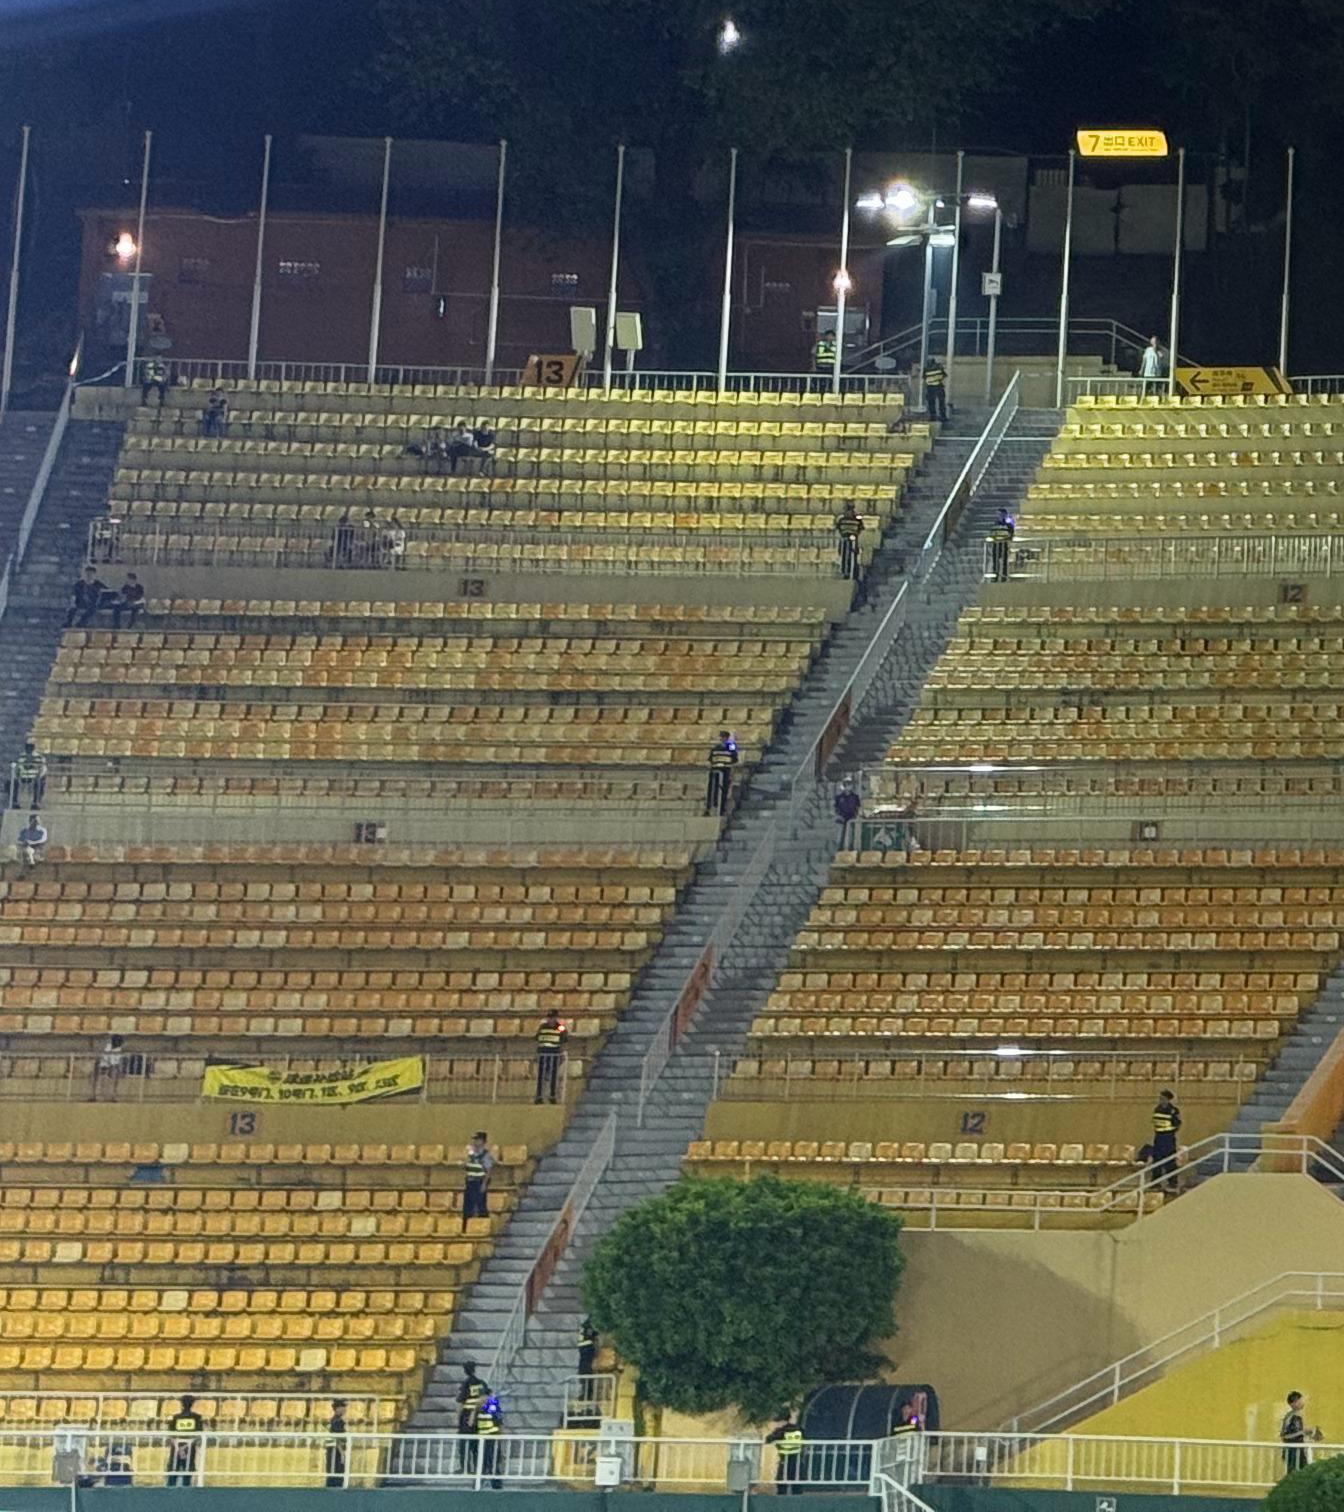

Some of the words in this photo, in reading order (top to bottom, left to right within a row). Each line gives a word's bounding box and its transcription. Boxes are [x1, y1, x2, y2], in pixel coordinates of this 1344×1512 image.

[1088, 134, 1100, 152] 7
[1127, 136, 1156, 147] EXIT
[536, 360, 564, 384] 13
[462, 579, 484, 597] 13
[1283, 584, 1303, 603] 12
[230, 1112, 256, 1135] 13
[962, 1111, 986, 1133] 12
